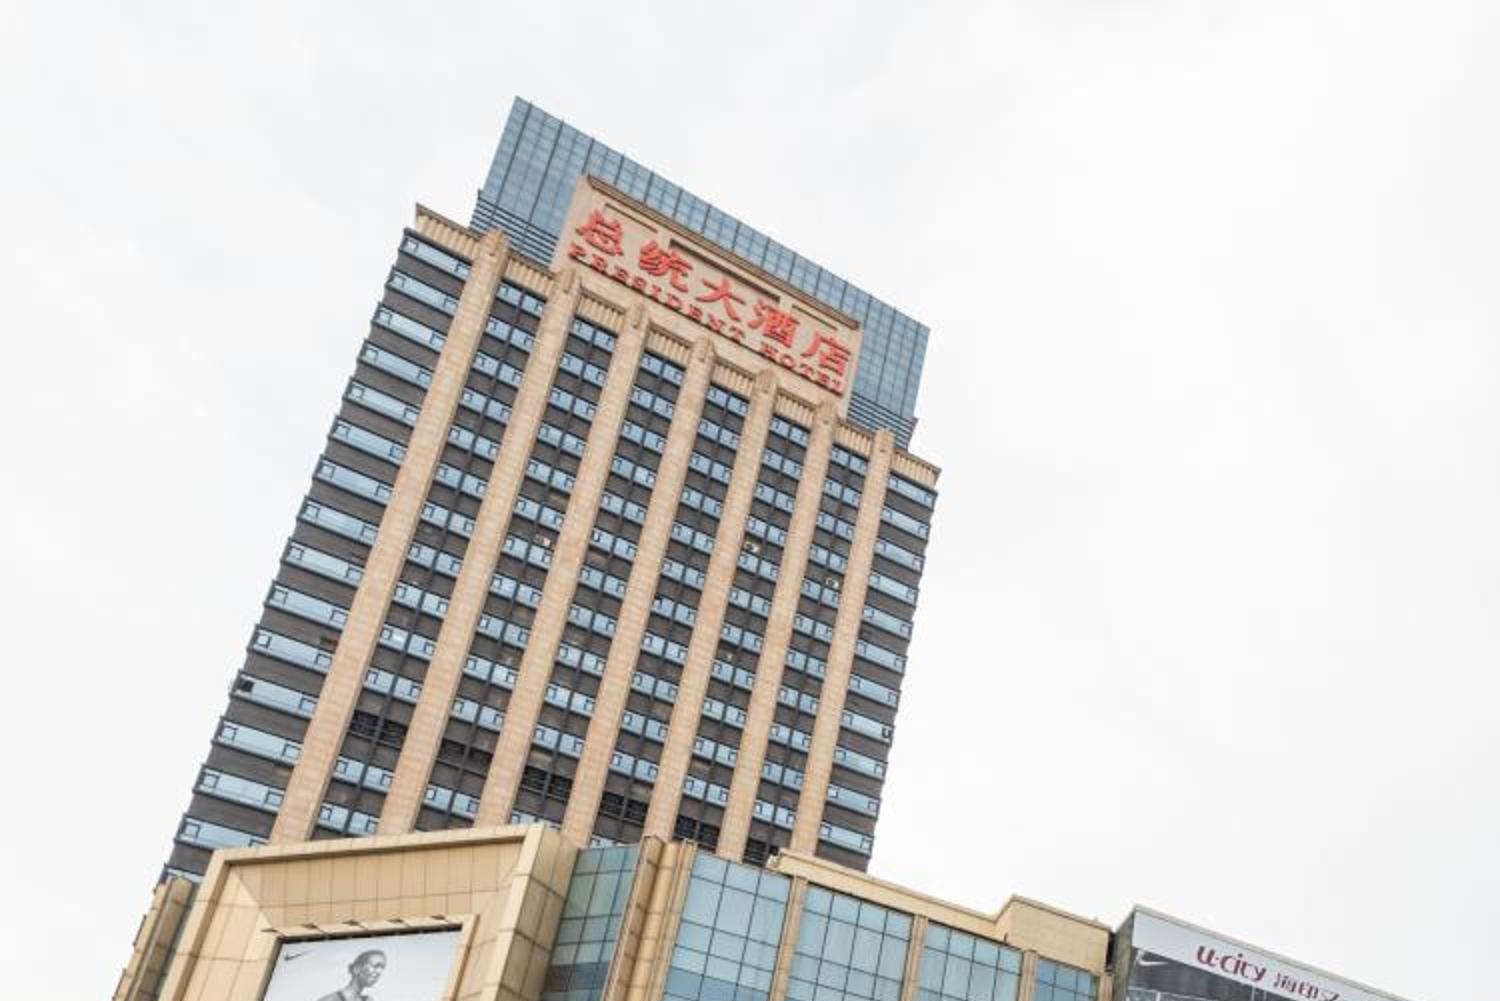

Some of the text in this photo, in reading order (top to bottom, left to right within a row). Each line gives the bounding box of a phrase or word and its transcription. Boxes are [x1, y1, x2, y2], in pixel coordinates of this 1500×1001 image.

[567, 241, 843, 388] PRESIDENT HOTEL
[576, 209, 852, 377] 总统大酒店
